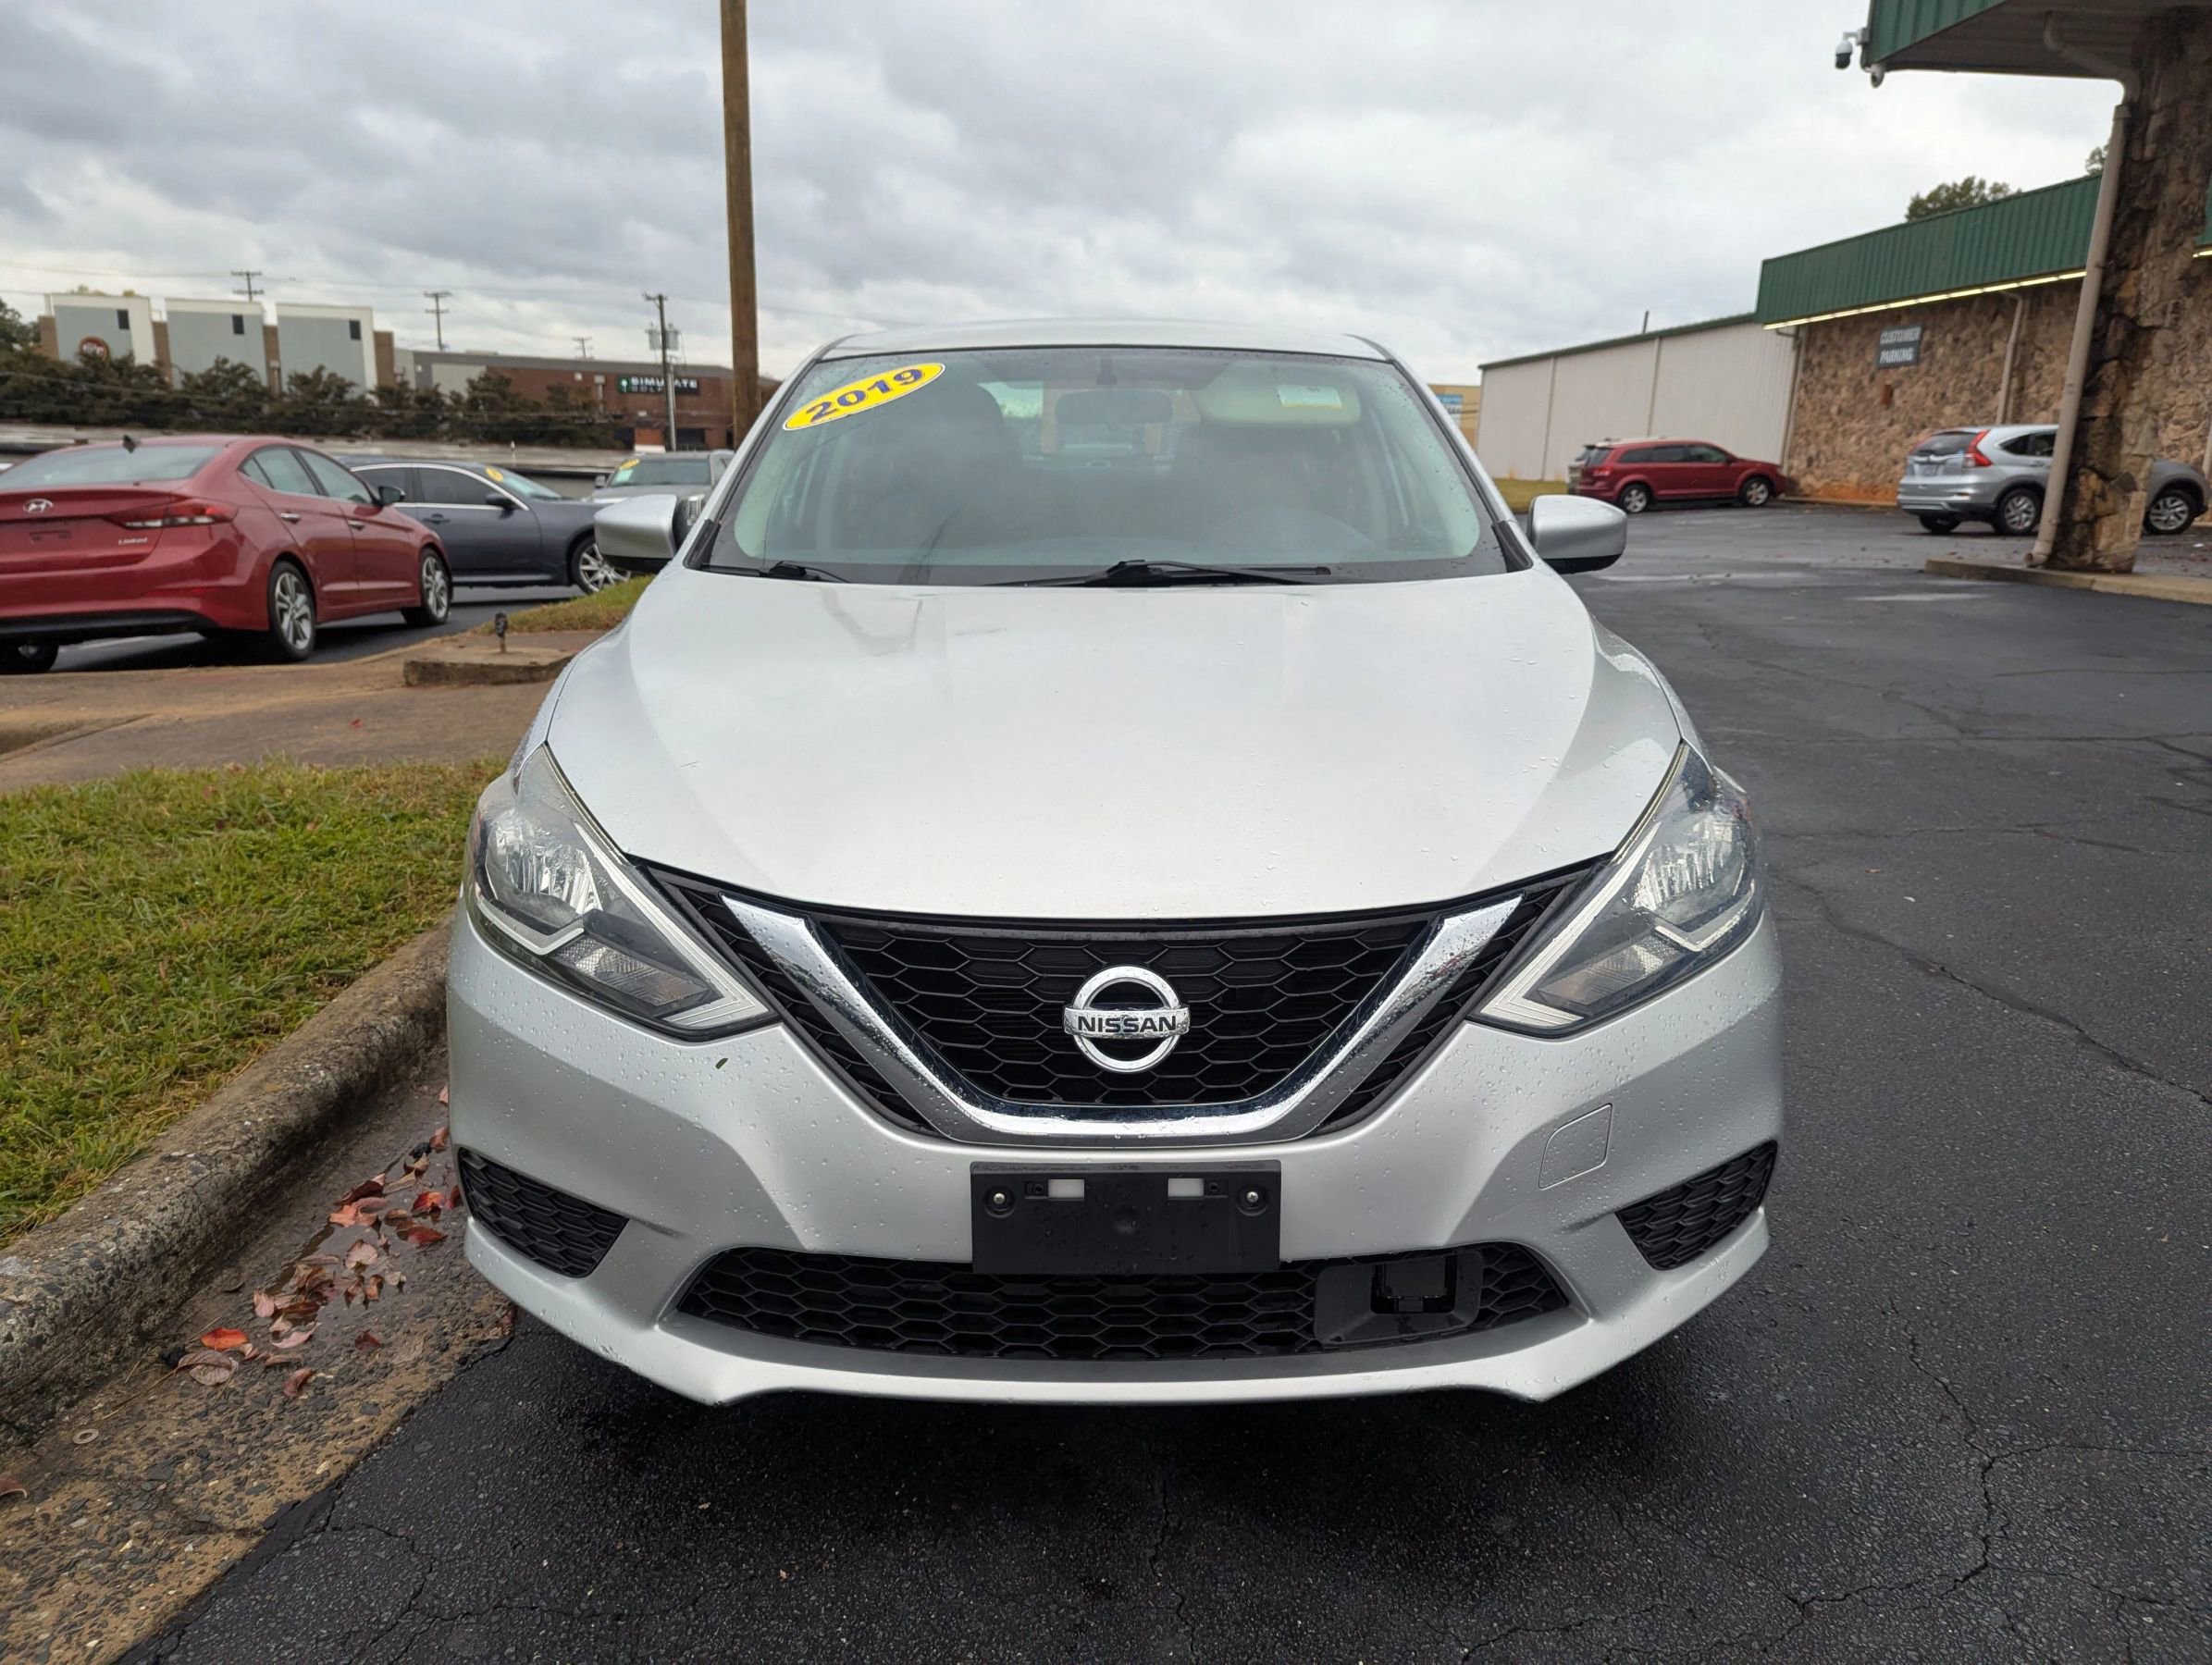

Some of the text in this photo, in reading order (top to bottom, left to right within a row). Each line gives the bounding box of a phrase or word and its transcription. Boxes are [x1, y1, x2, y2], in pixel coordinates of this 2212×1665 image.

[1879, 347, 1915, 364] PARKING
[631, 376, 698, 388] SIMUATE
[806, 368, 924, 424] 2019
[1078, 1015, 1177, 1034] NISSAN
